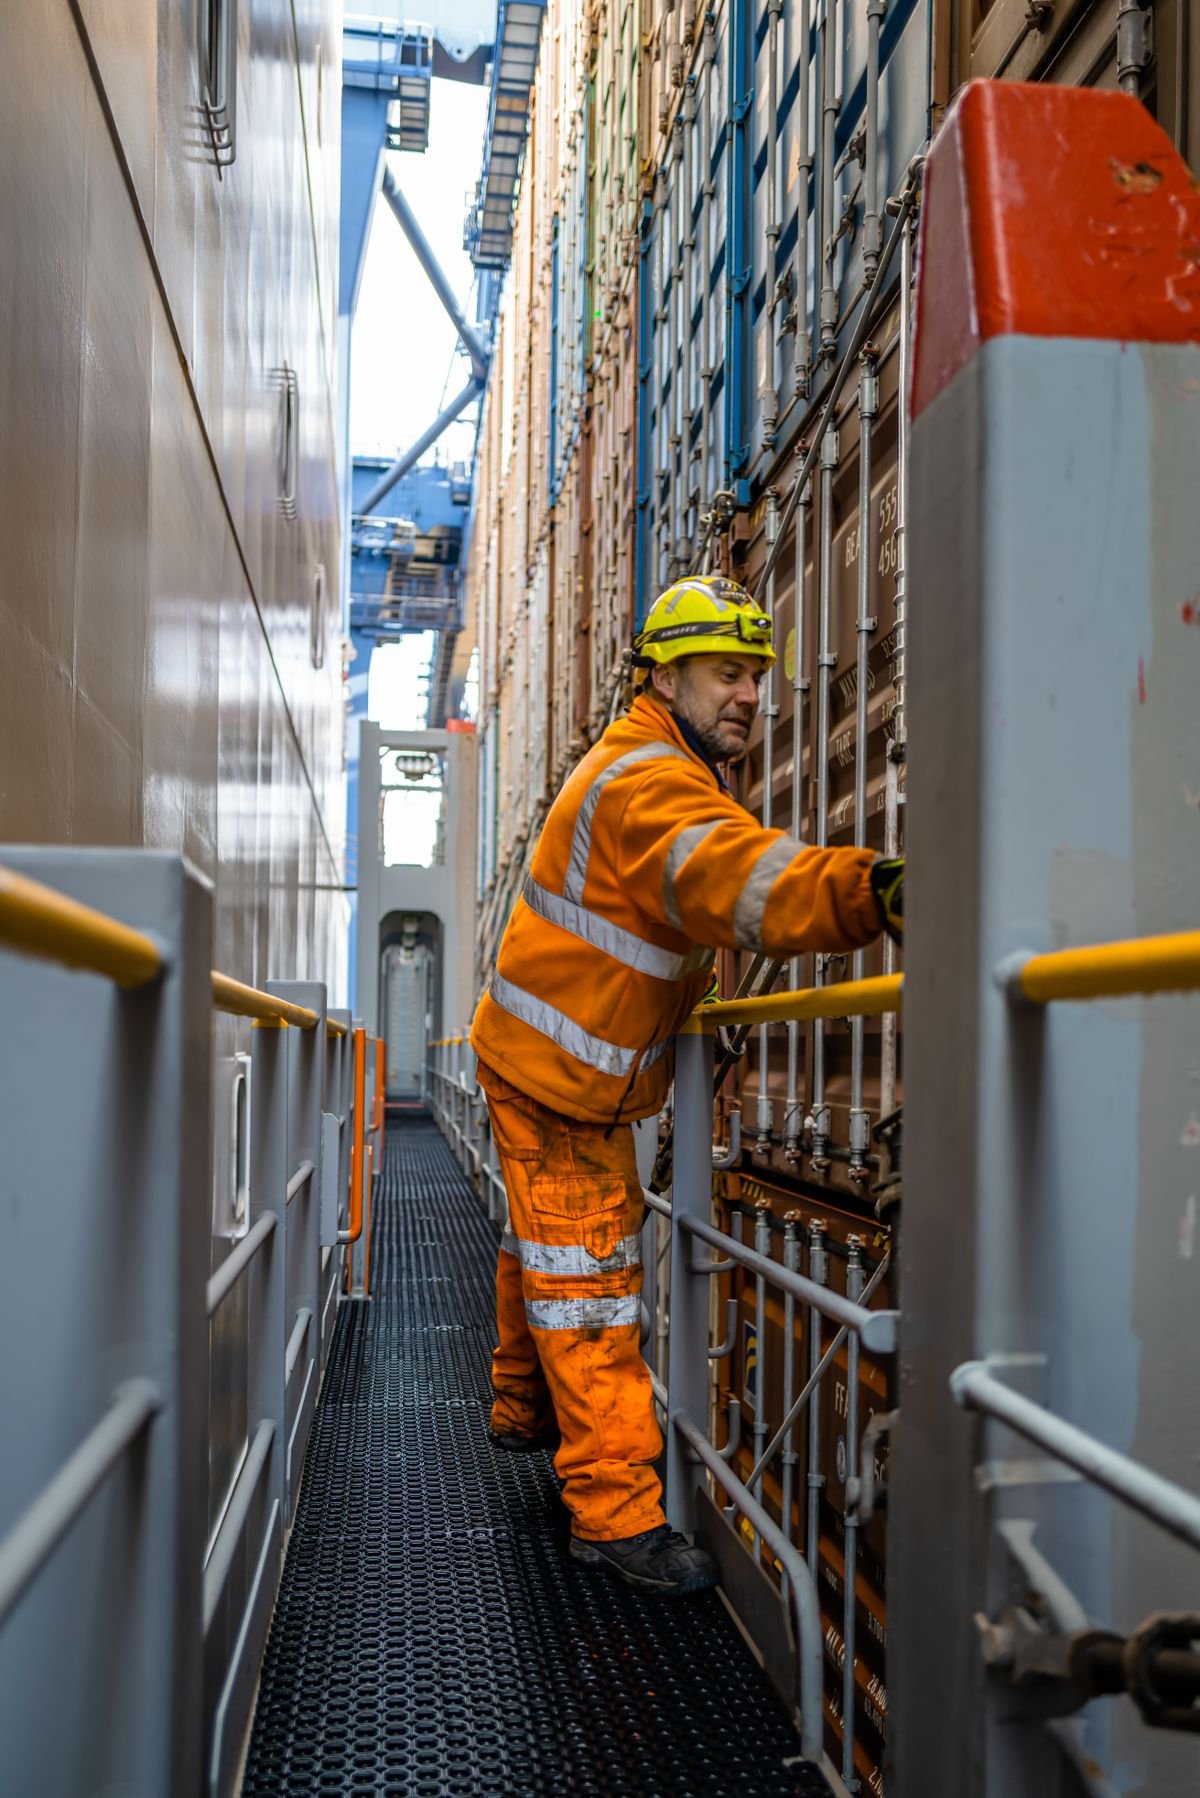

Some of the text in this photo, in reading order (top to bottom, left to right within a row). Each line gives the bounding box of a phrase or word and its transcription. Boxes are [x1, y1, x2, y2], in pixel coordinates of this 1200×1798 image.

[845, 486, 897, 569] BEA 555
[878, 534, 897, 577] 45G
[835, 1380, 848, 1419] FFA
